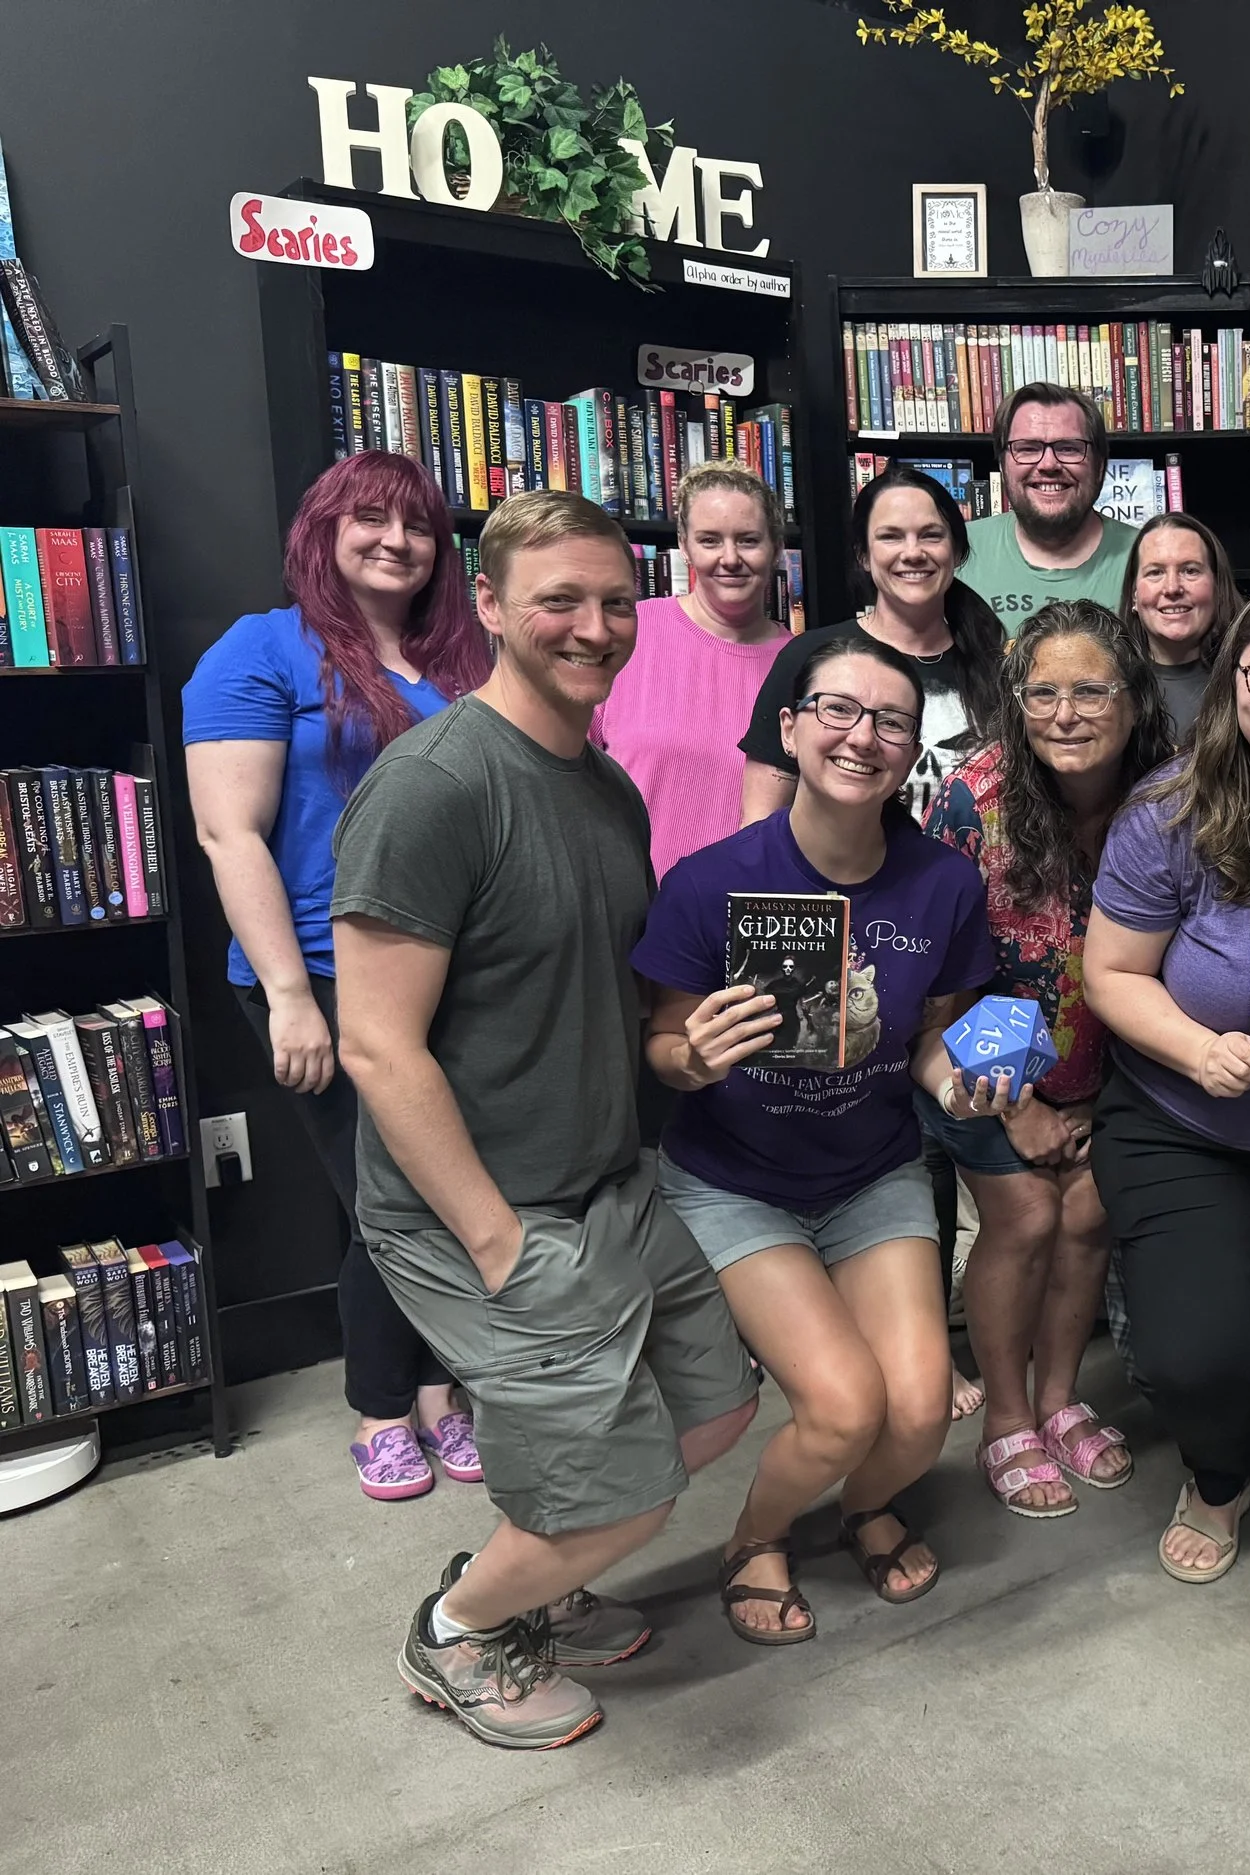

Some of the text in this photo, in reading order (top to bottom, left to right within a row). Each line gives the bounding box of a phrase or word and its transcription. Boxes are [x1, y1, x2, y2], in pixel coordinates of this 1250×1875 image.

[308, 75, 770, 258] HOME
[239, 198, 358, 267] Scaries
[1077, 209, 1160, 250] Cozy
[721, 273, 744, 285] order
[747, 275, 758, 291] by
[760, 279, 789, 292] author
[645, 352, 743, 387] Scaries
[330, 374, 345, 443] NO EXIT
[369, 367, 382, 433] THE UNSEEN
[427, 384, 437, 408] DAVID
[447, 386, 458, 409] DAVID
[429, 409, 441, 445] BALDACCI
[448, 411, 461, 447] BALDACCI
[470, 392, 483, 455] DAVID BALDACCI
[486, 392, 502, 465] DAVID BALDACCI
[507, 381, 525, 461] DAVID BALDACCI
[723, 405, 735, 462] HARLAN COBEN
[531, 416, 543, 472] DAVID BALDACCI
[550, 417, 560, 470] DAVID BALDACCI
[737, 430, 748, 458] HARLAN
[780, 408, 795, 510] ALLY CONDIE THE UNWEDDING
[631, 428, 646, 496] SANDRA BROWN
[489, 466, 506, 498] MERCY
[1112, 485, 1138, 503] BY
[19, 534, 29, 564] SARAH
[51, 537, 78, 547] MAAS
[89, 541, 97, 560] MAAS
[113, 540, 121, 557] MAAS
[55, 577, 82, 587] CITY
[17, 781, 37, 854] BRISTOL KEATS
[122, 803, 141, 889] VEILED KINGDOM
[5, 862, 17, 896] ABIGAIL
[35, 870, 46, 903] PEARSON
[62, 869, 74, 901] PEARSON
[745, 902, 832, 912] TAMSYN MUIR
[751, 941, 826, 951] THE NINTH
[865, 920, 932, 954] Posse
[955, 1022, 972, 1045] 7
[1008, 1005, 1031, 1028] 17
[975, 1027, 1003, 1056] 15
[1036, 1028, 1048, 1046] 3
[36, 1052, 50, 1081] LEGACY
[799, 1076, 821, 1091] FAN
[825, 1070, 862, 1086] CLUB
[865, 1059, 909, 1078] MEMBE
[990, 1065, 1016, 1078] 8
[1025, 1056, 1046, 1078] 10
[794, 1085, 858, 1101] EARTH DIVISION
[794, 1104, 805, 1112] TO
[53, 1102, 76, 1155] STANWYCK
[19, 1299, 37, 1350] TAD WILLIAMS
[86, 1349, 101, 1391] BREAKER
[97, 1348, 111, 1388] HEAVEN
[115, 1344, 130, 1387] BREAKER
[126, 1343, 140, 1383] HEAVEN
[162, 1342, 171, 1371] WOODS
[0, 1343, 15, 1414] WILLIAMS
